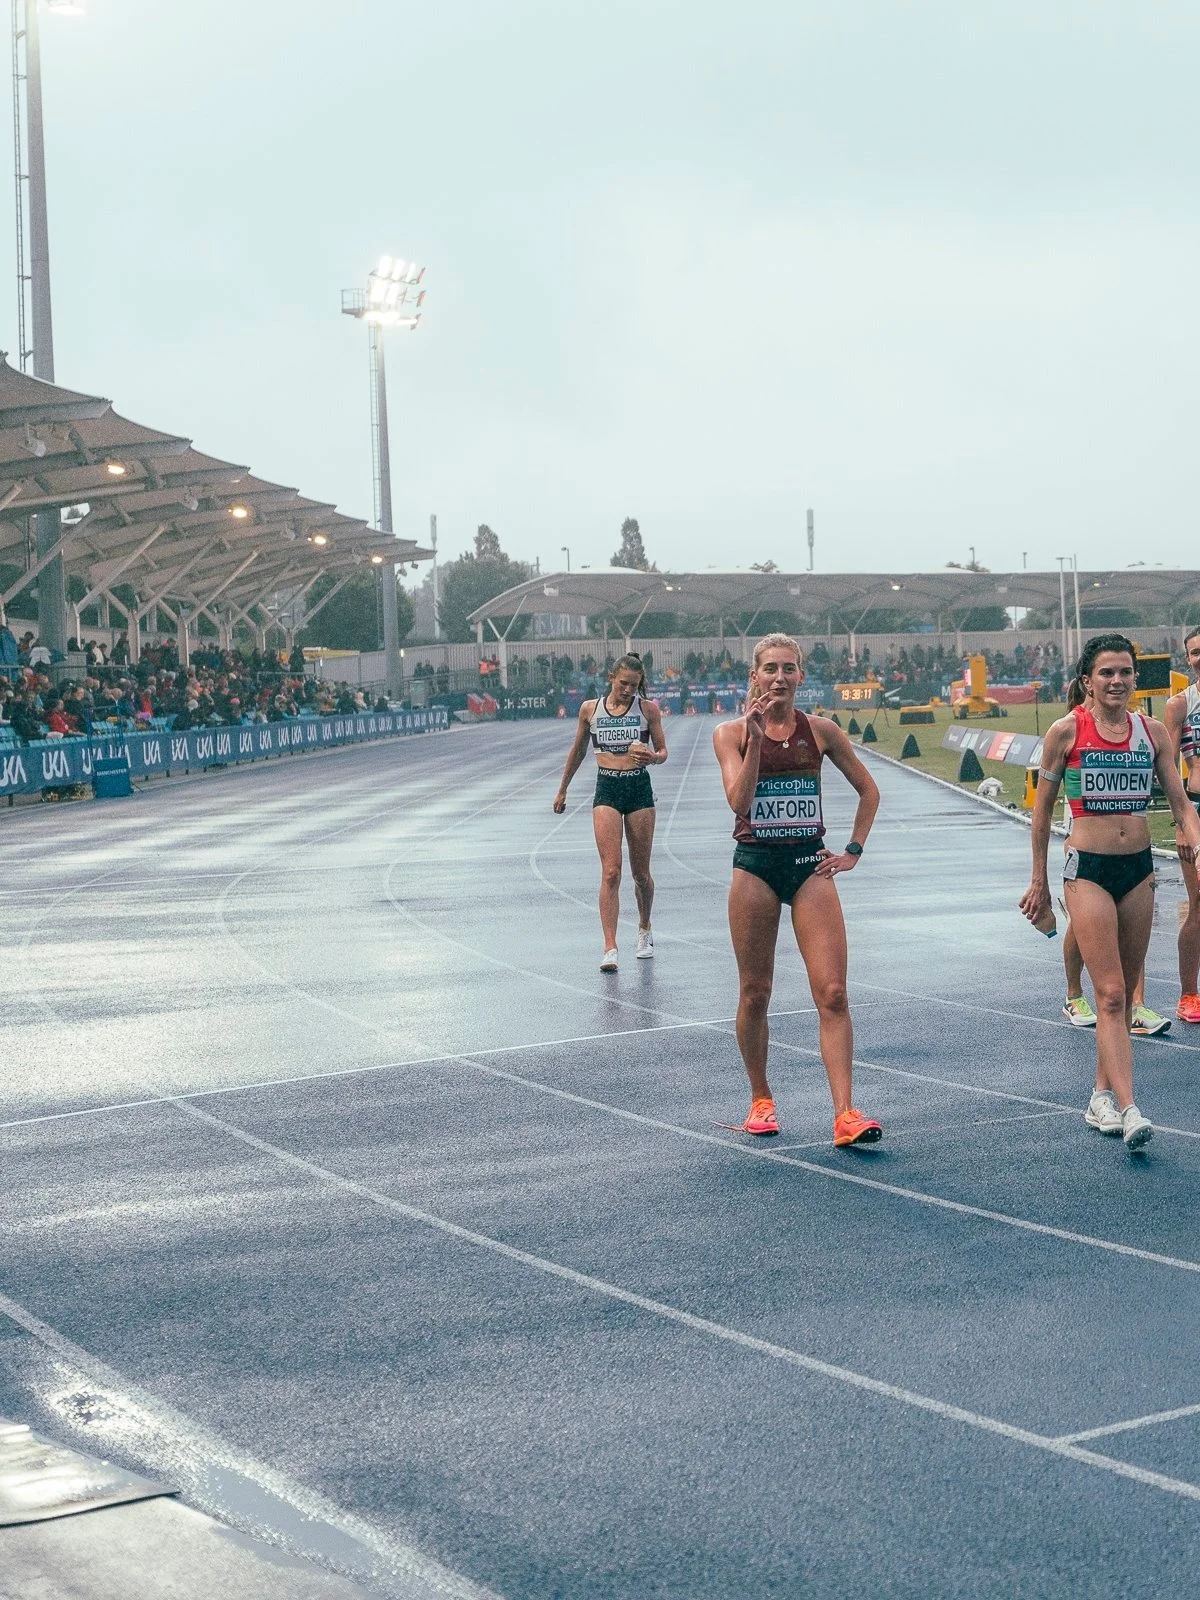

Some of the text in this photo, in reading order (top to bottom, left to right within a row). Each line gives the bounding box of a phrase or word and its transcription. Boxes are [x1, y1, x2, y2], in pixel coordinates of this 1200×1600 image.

[841, 688, 872, 700] 19:38:11
[599, 729, 639, 741] FITZGERALD
[42, 750, 70, 780] UKA
[143, 741, 161, 765] UKA
[171, 737, 189, 761] UKA
[197, 735, 214, 759] UKA
[217, 734, 231, 755] UKA
[240, 732, 253, 753] UKA
[260, 730, 272, 750] UKA
[278, 727, 290, 747] UKA
[291, 725, 302, 746] UKA
[599, 769, 619, 777] NIKE
[1085, 773, 1148, 791] BOWDEN
[755, 800, 817, 819] AXFORD
[1087, 801, 1146, 811] MANCHESTER
[756, 827, 818, 838] MANCHESTER
